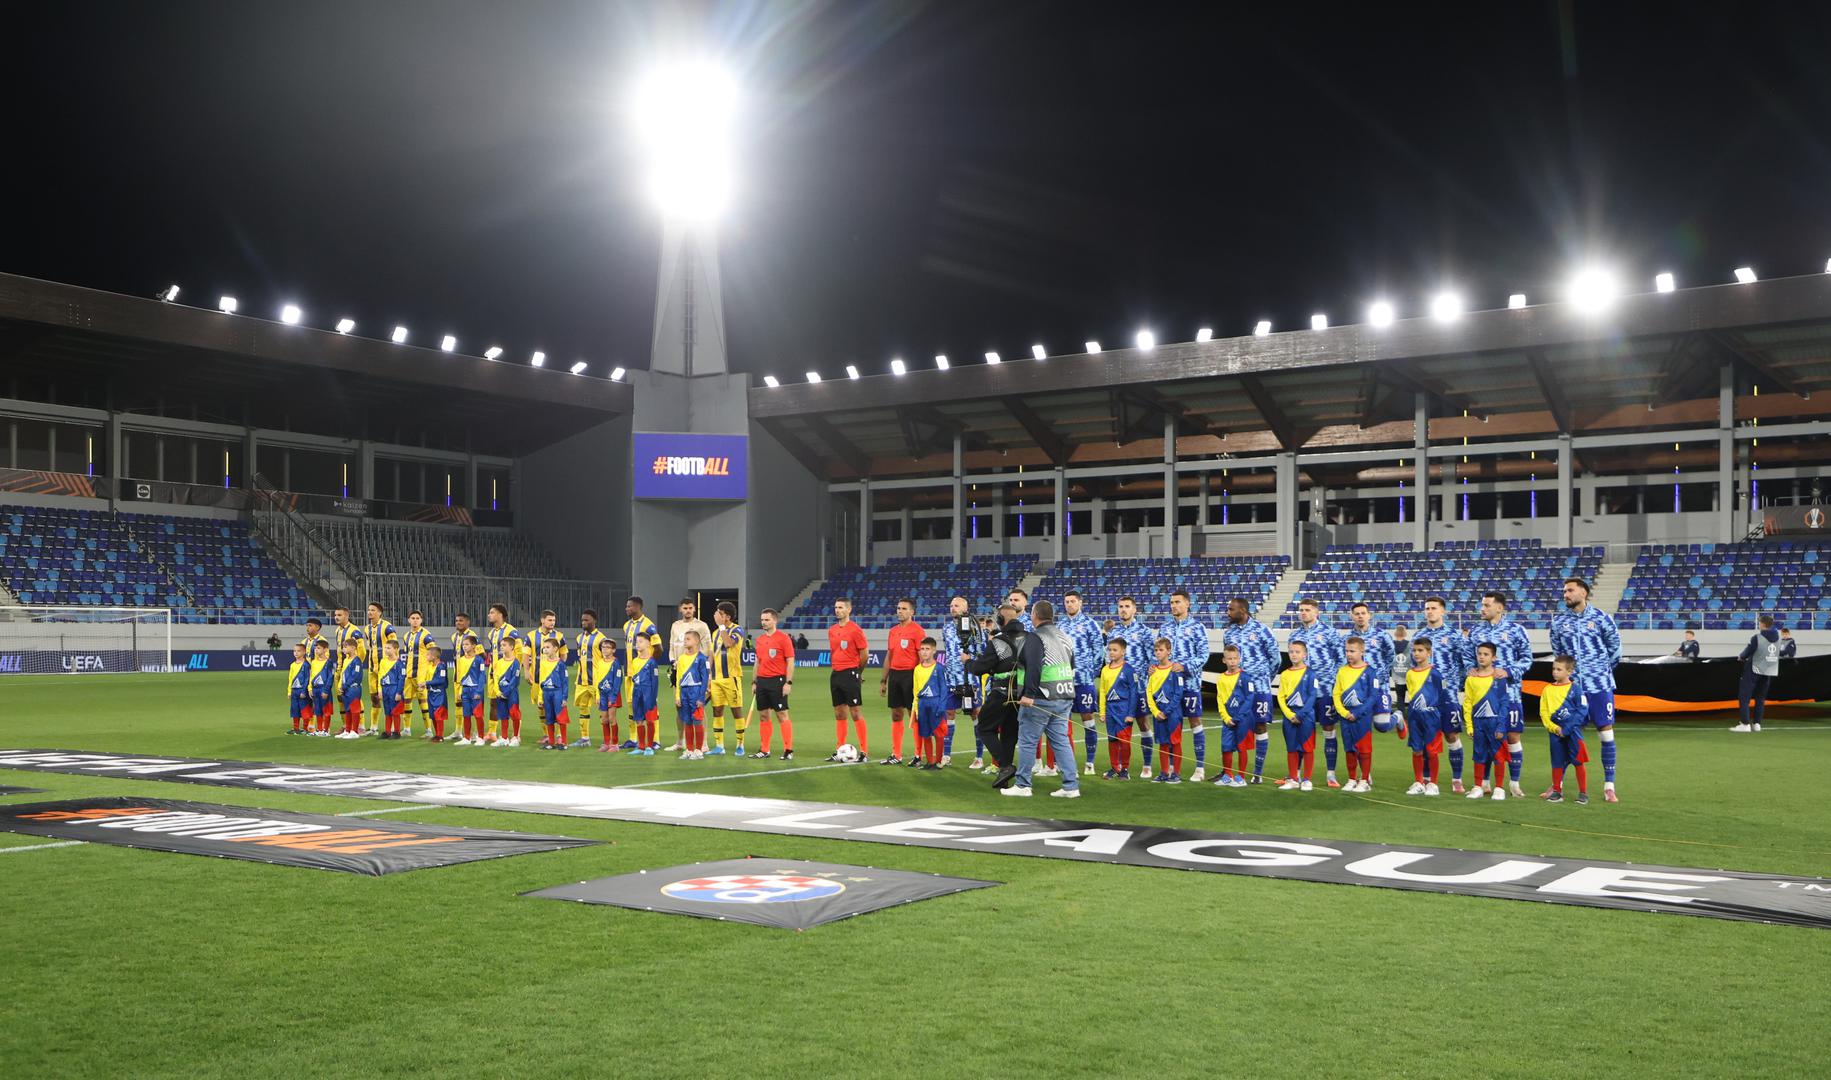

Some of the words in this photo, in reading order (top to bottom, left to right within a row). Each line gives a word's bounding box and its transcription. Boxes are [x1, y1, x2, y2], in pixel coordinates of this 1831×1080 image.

[652, 456, 729, 476] #FOOTBALL
[62, 655, 104, 670] UEFA
[189, 653, 208, 669] ALL
[241, 654, 277, 668] UEFA
[742, 653, 757, 664] UE
[867, 653, 880, 665] FA
[1056, 682, 1074, 695] 013
[1081, 693, 1093, 705] 26
[1184, 696, 1198, 709] 77
[1256, 701, 1269, 714] 28
[1606, 702, 1613, 716] 9
[1509, 710, 1519, 723] 11
[15, 807, 466, 855] #FOOTBALL
[178, 767, 795, 818] EURO
[741, 809, 1743, 903] LEAGUE
